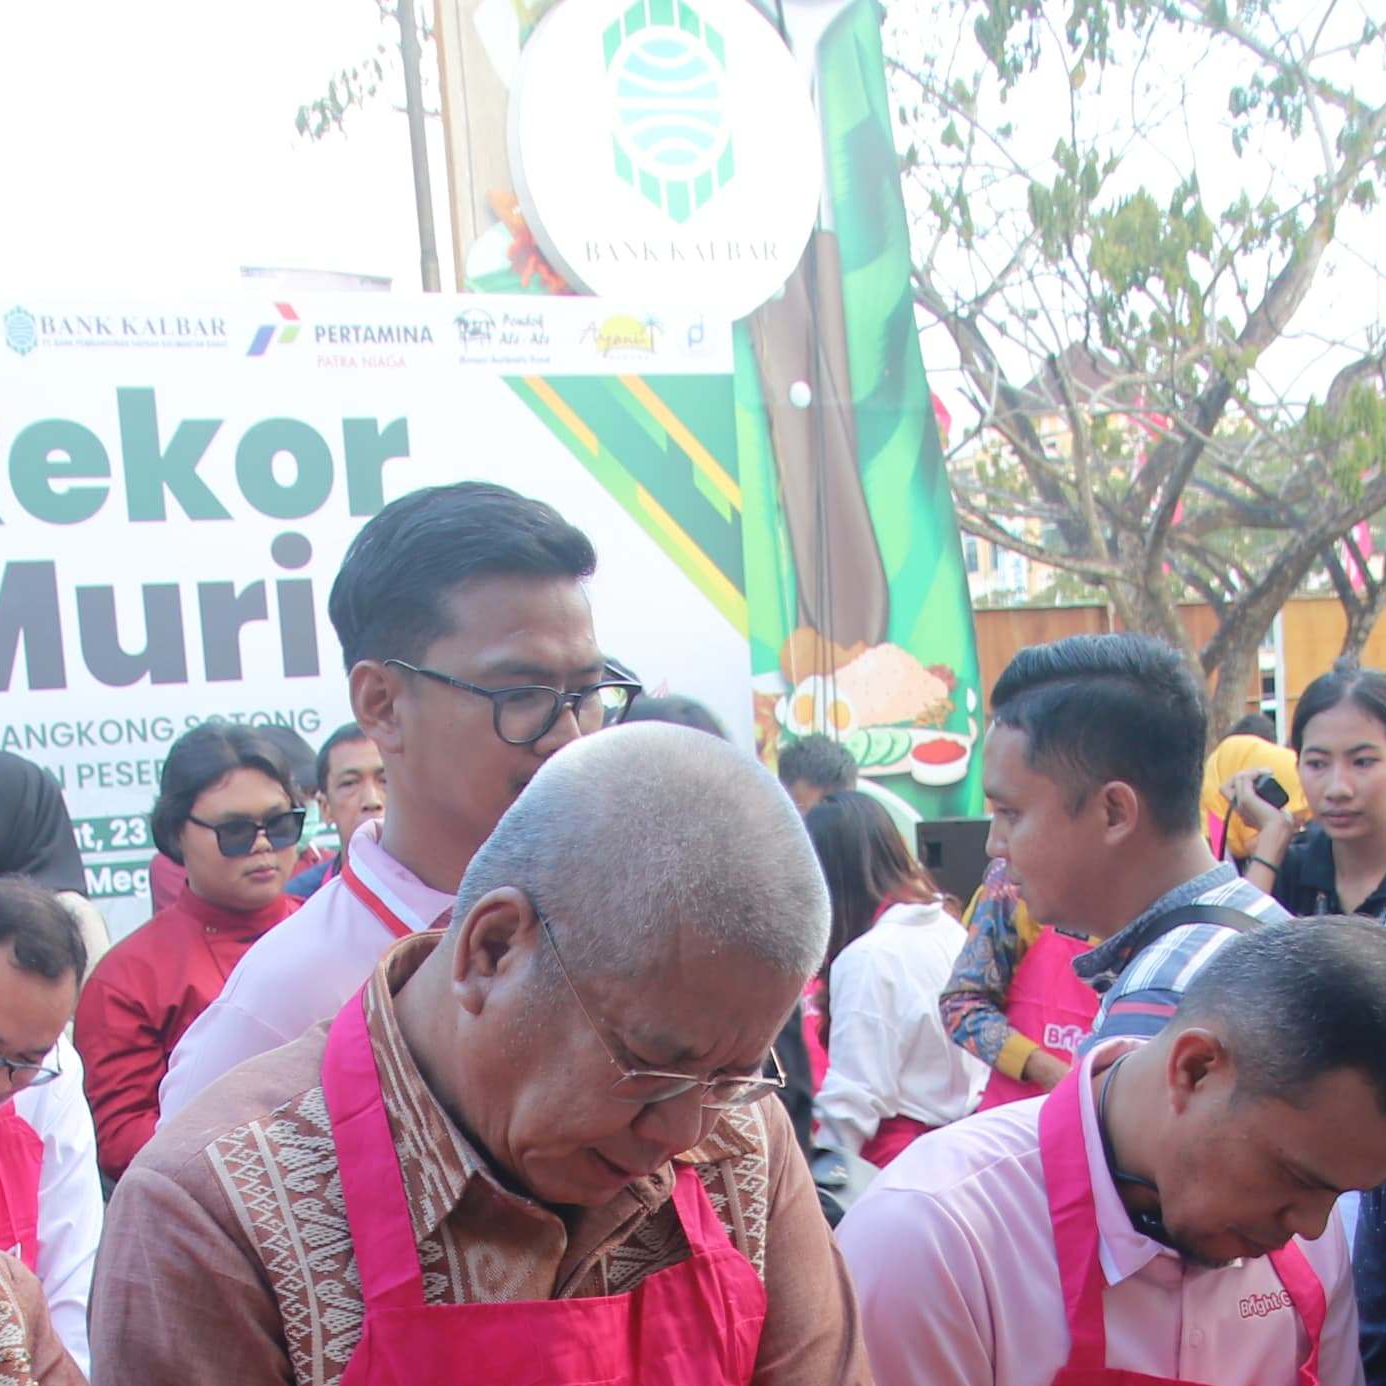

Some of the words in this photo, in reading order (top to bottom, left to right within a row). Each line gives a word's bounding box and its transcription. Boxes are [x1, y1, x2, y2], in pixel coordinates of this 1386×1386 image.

[585, 240, 659, 263] BANK
[41, 316, 113, 336] BANK
[122, 317, 227, 337] KALBAR
[315, 325, 433, 345] PERTAMINA
[317, 355, 359, 368] PATRA
[362, 356, 406, 369] NIAGA
[77, 760, 164, 789] PESE
[110, 817, 147, 846] 23
[85, 868, 149, 897] Meg
[1239, 1294, 1281, 1318] Bright
